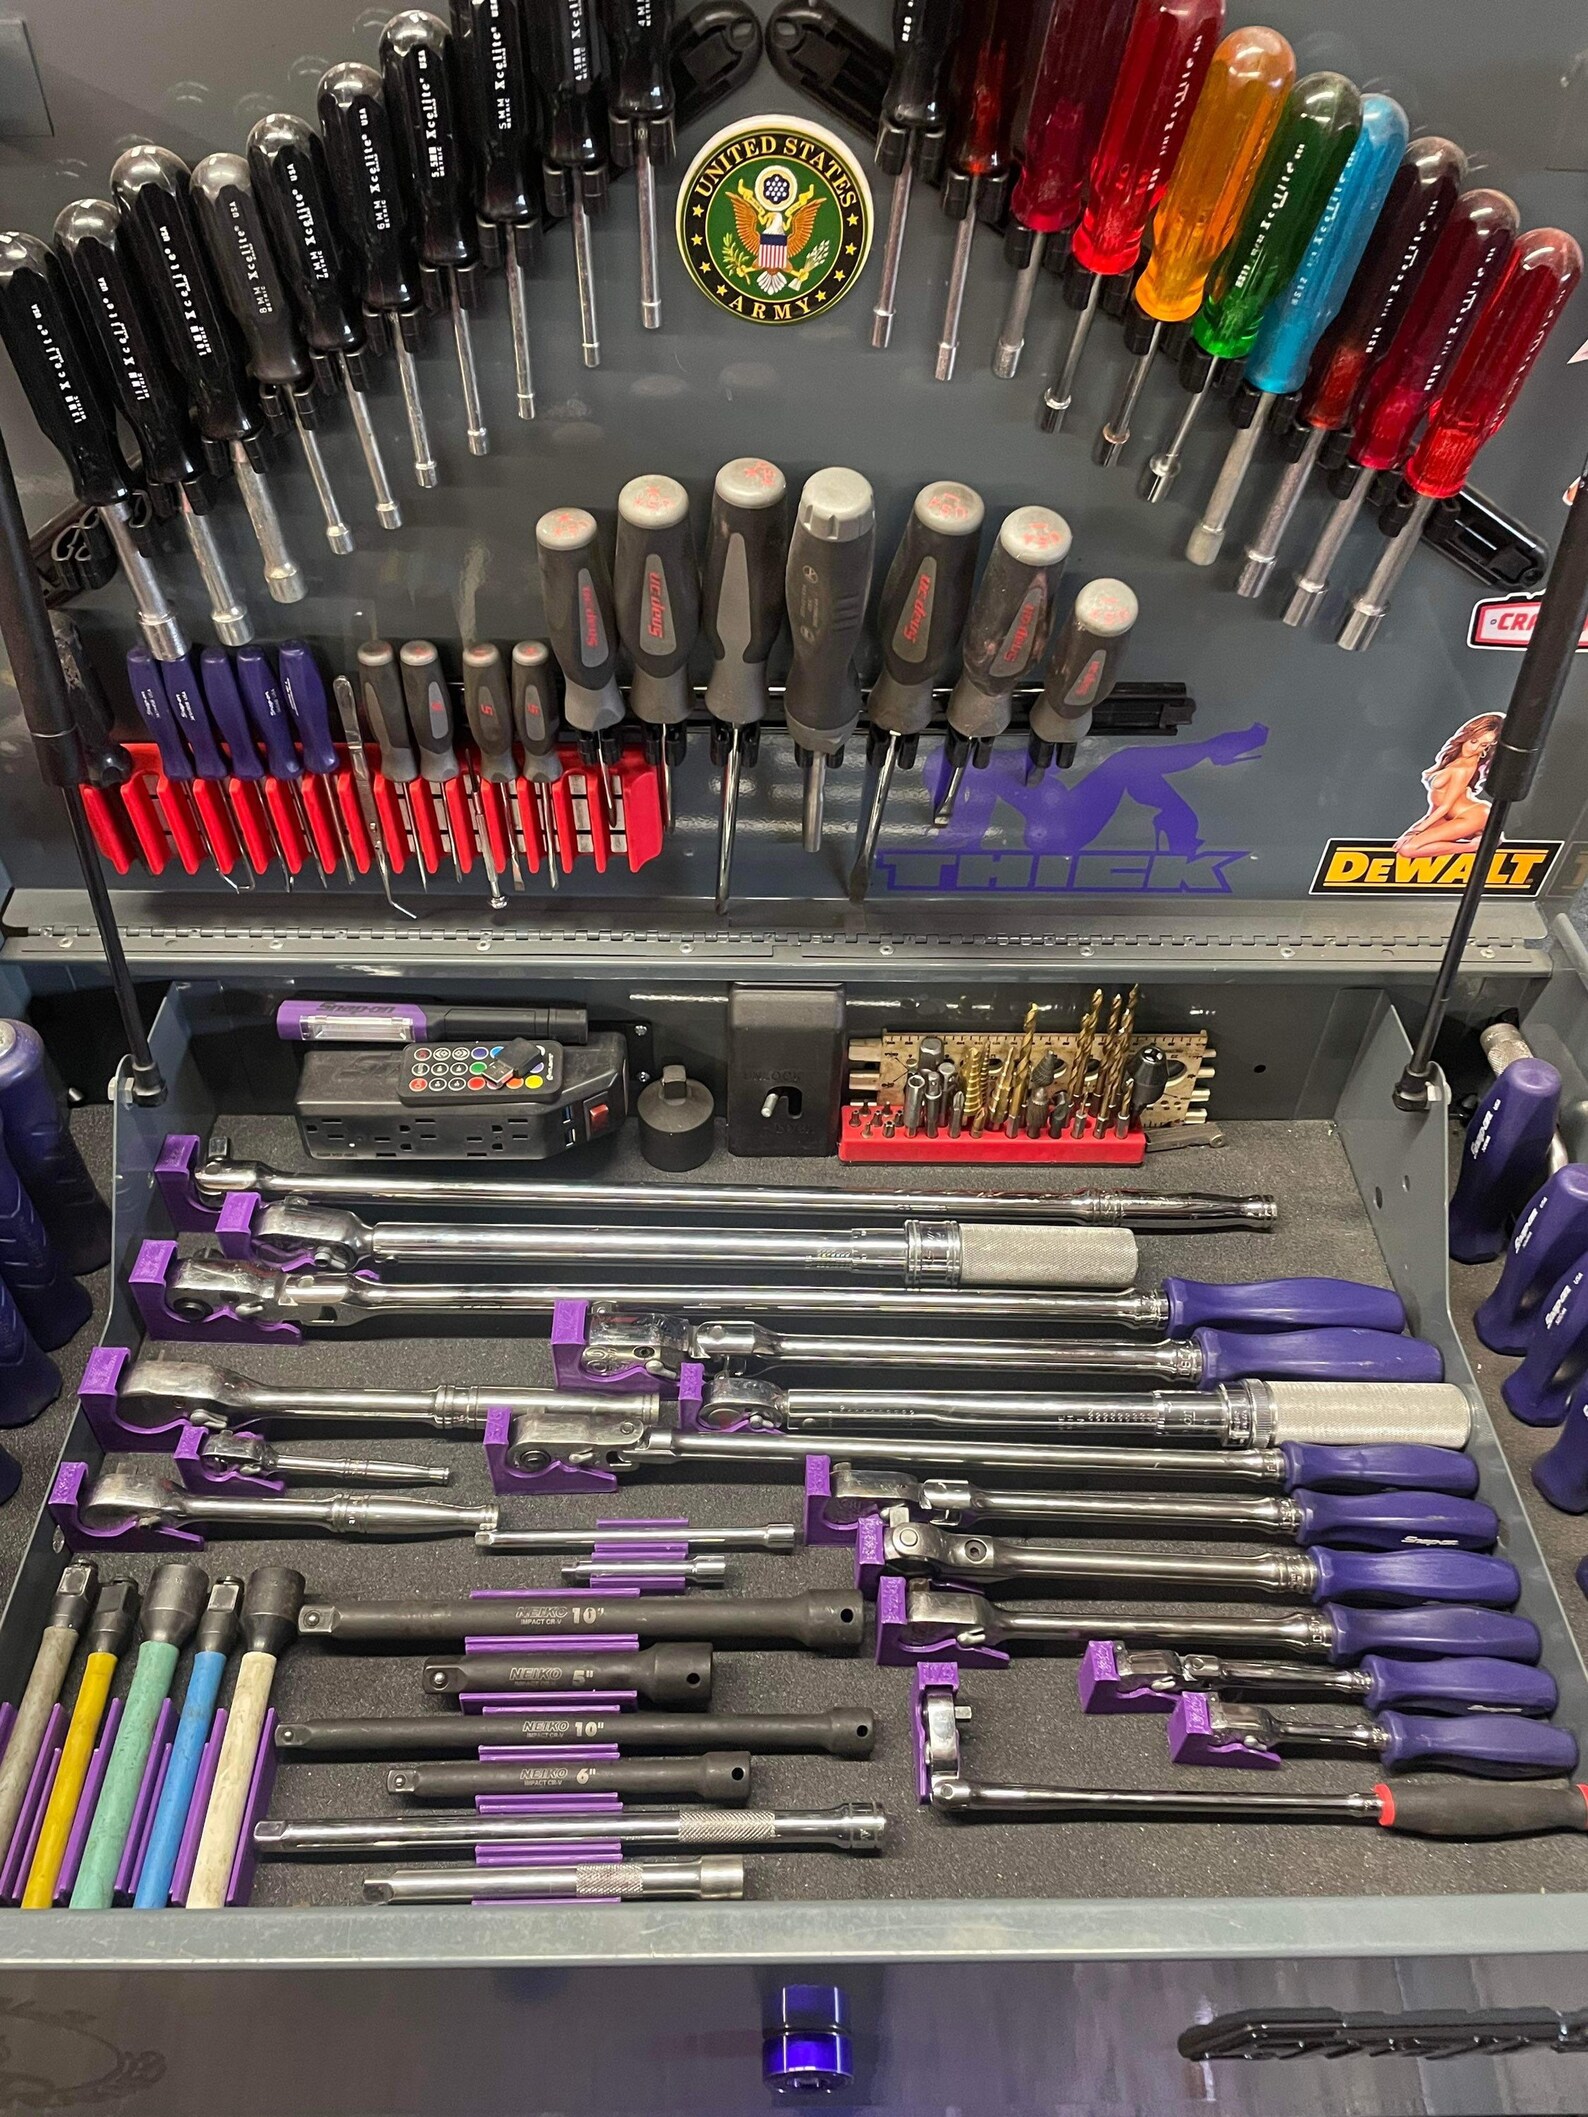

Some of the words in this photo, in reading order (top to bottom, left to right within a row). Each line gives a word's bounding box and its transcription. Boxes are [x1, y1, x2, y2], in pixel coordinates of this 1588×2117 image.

[568, 0, 581, 39] Xcel
[358, 108, 369, 126] USA
[286, 163, 298, 182] USA
[694, 136, 777, 197] UNITED
[783, 136, 857, 208] STATES
[229, 201, 240, 219] USA
[729, 295, 811, 320] ARMY
[649, 571, 664, 639] Snap-on
[903, 574, 931, 643] Snap-on
[876, 850, 1254, 893] THICK
[316, 1002, 395, 1016] Snap-on
[515, 1606, 568, 1618] NEIKO
[509, 1667, 562, 1681] NEIKO
[522, 1721, 569, 1732] NEIKO
[574, 1721, 604, 1737] 10"
[520, 1768, 568, 1780] NEIKO
[576, 1768, 596, 1785] 6"
